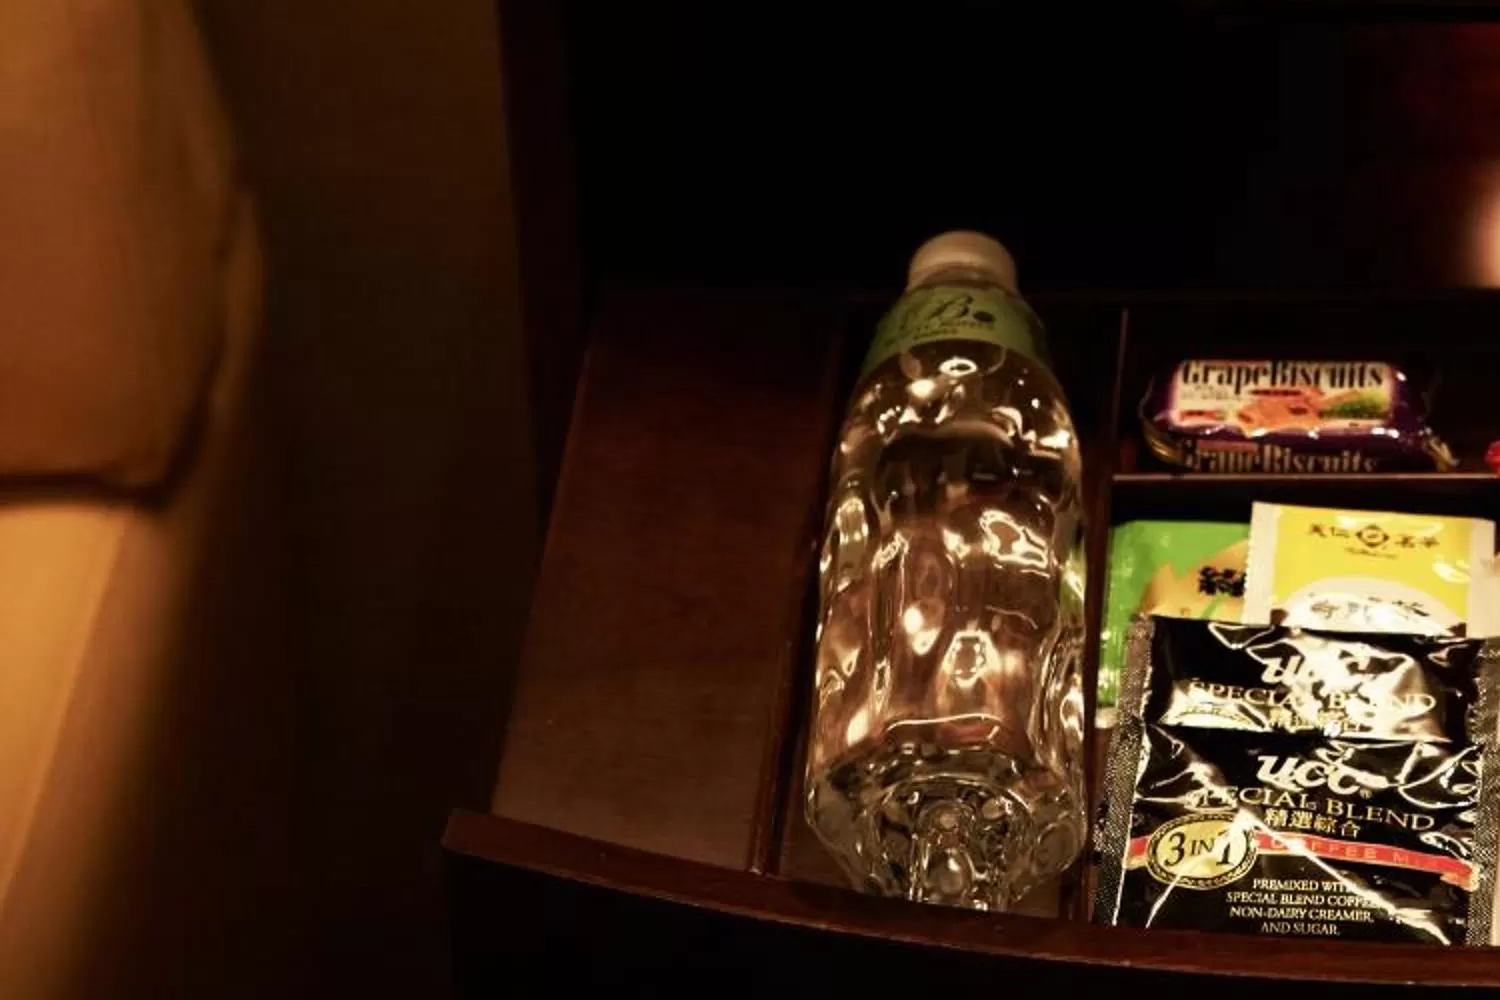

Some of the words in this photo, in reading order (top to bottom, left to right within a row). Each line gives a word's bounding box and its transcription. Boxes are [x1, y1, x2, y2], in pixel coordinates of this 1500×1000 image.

[1181, 360, 1384, 394] GrapeBiscuits
[1188, 680, 1310, 709] SPECIA
[1185, 784, 1317, 811] PECIAL
[1326, 797, 1436, 831] BLEND
[1263, 807, 1362, 839] 精選綜合
[1164, 830, 1187, 867] 3
[1190, 837, 1216, 857] IN
[1217, 829, 1235, 866] 1
[1271, 836, 1378, 860] CFFEE
[1253, 878, 1319, 892] PREMIXED
[1225, 891, 1277, 904] SPECIAL
[1280, 892, 1325, 906] BLEND
[1229, 906, 1308, 919] NON-DAIRY
[1261, 921, 1291, 935] AND
